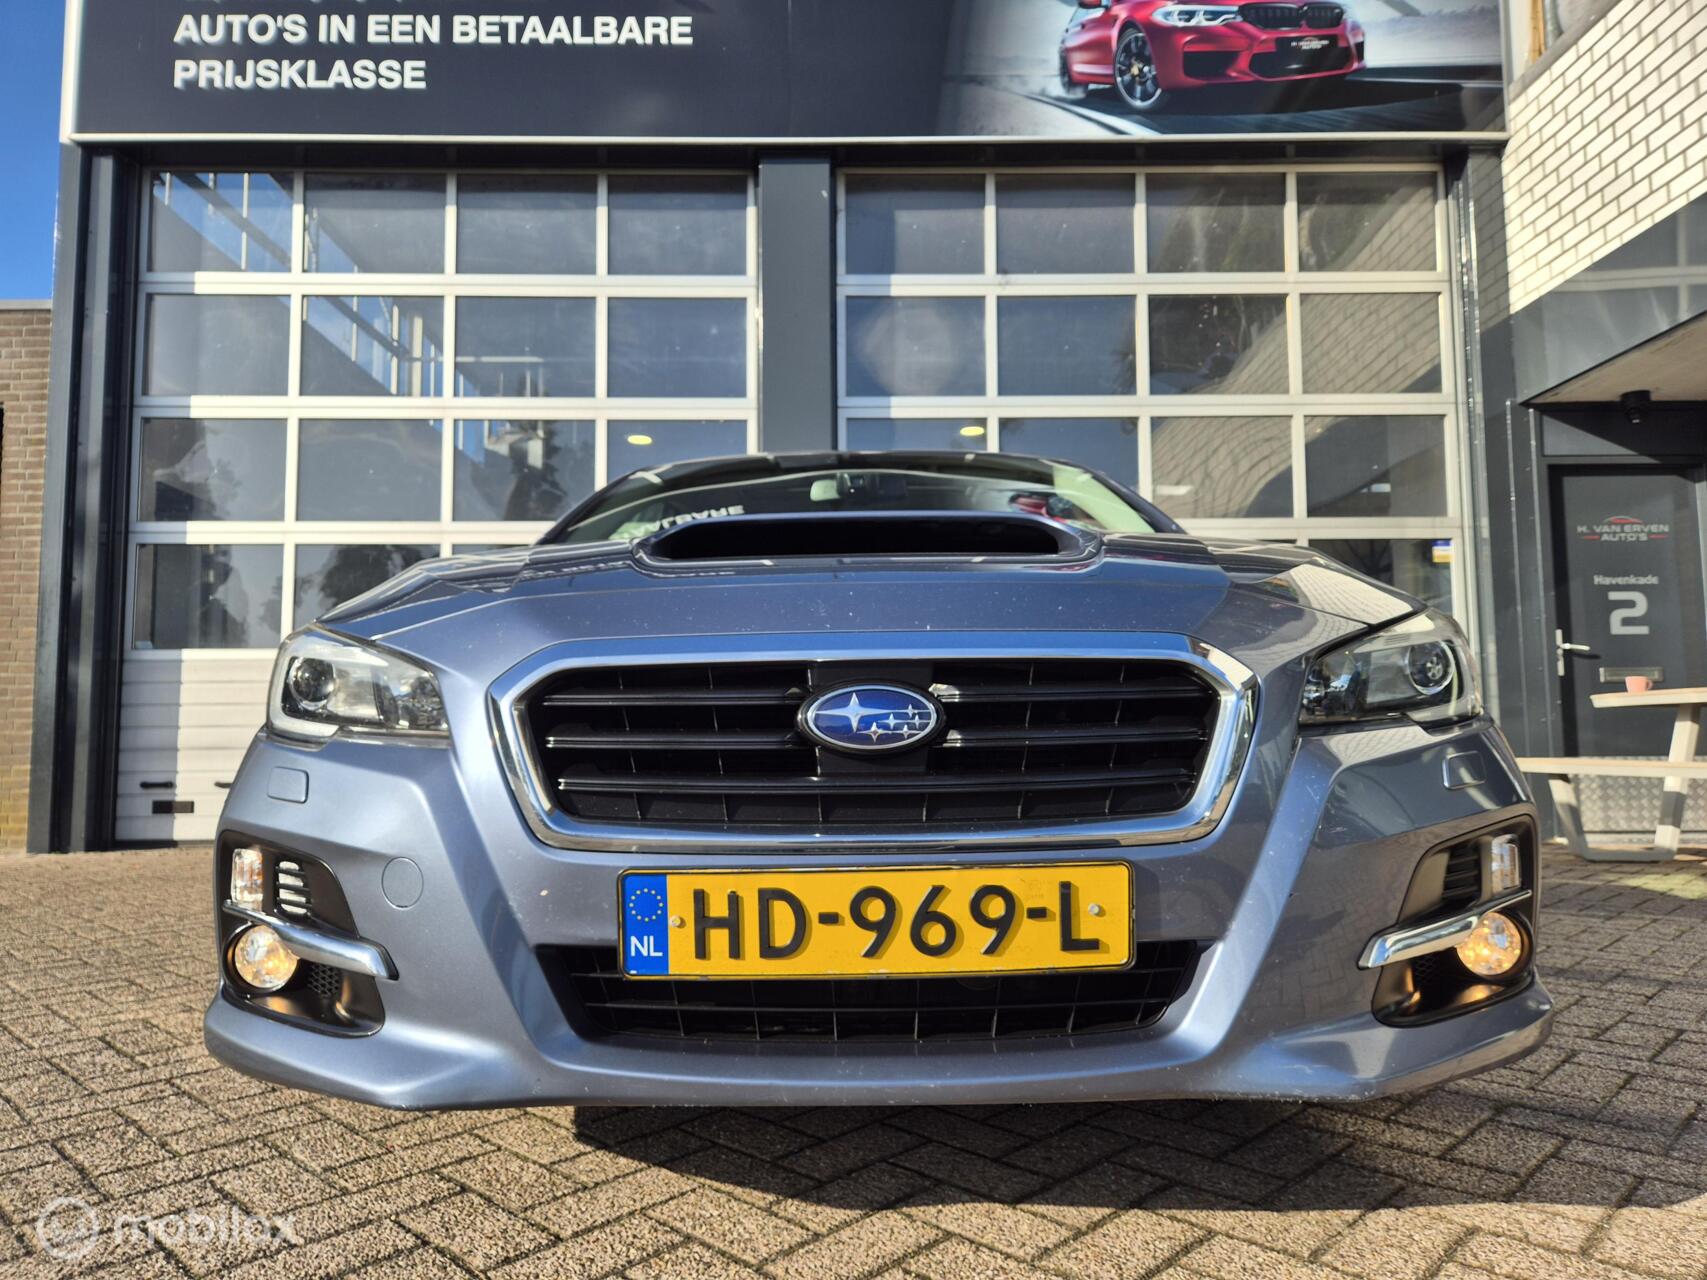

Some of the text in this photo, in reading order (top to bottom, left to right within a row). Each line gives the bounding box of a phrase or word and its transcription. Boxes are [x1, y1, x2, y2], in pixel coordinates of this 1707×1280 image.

[173, 14, 694, 45] AUTO'S IN EEN BETAALBARE
[173, 59, 427, 90] PRIJSKLASSE
[1593, 524, 1621, 533] VAN
[1623, 523, 1670, 533] ERVEN
[1600, 533, 1649, 542] AUTO'S
[1593, 574, 1659, 585] Havenkade
[1608, 591, 1650, 635] 2
[692, 881, 1101, 960] HD-969-L
[630, 935, 664, 957] NL
